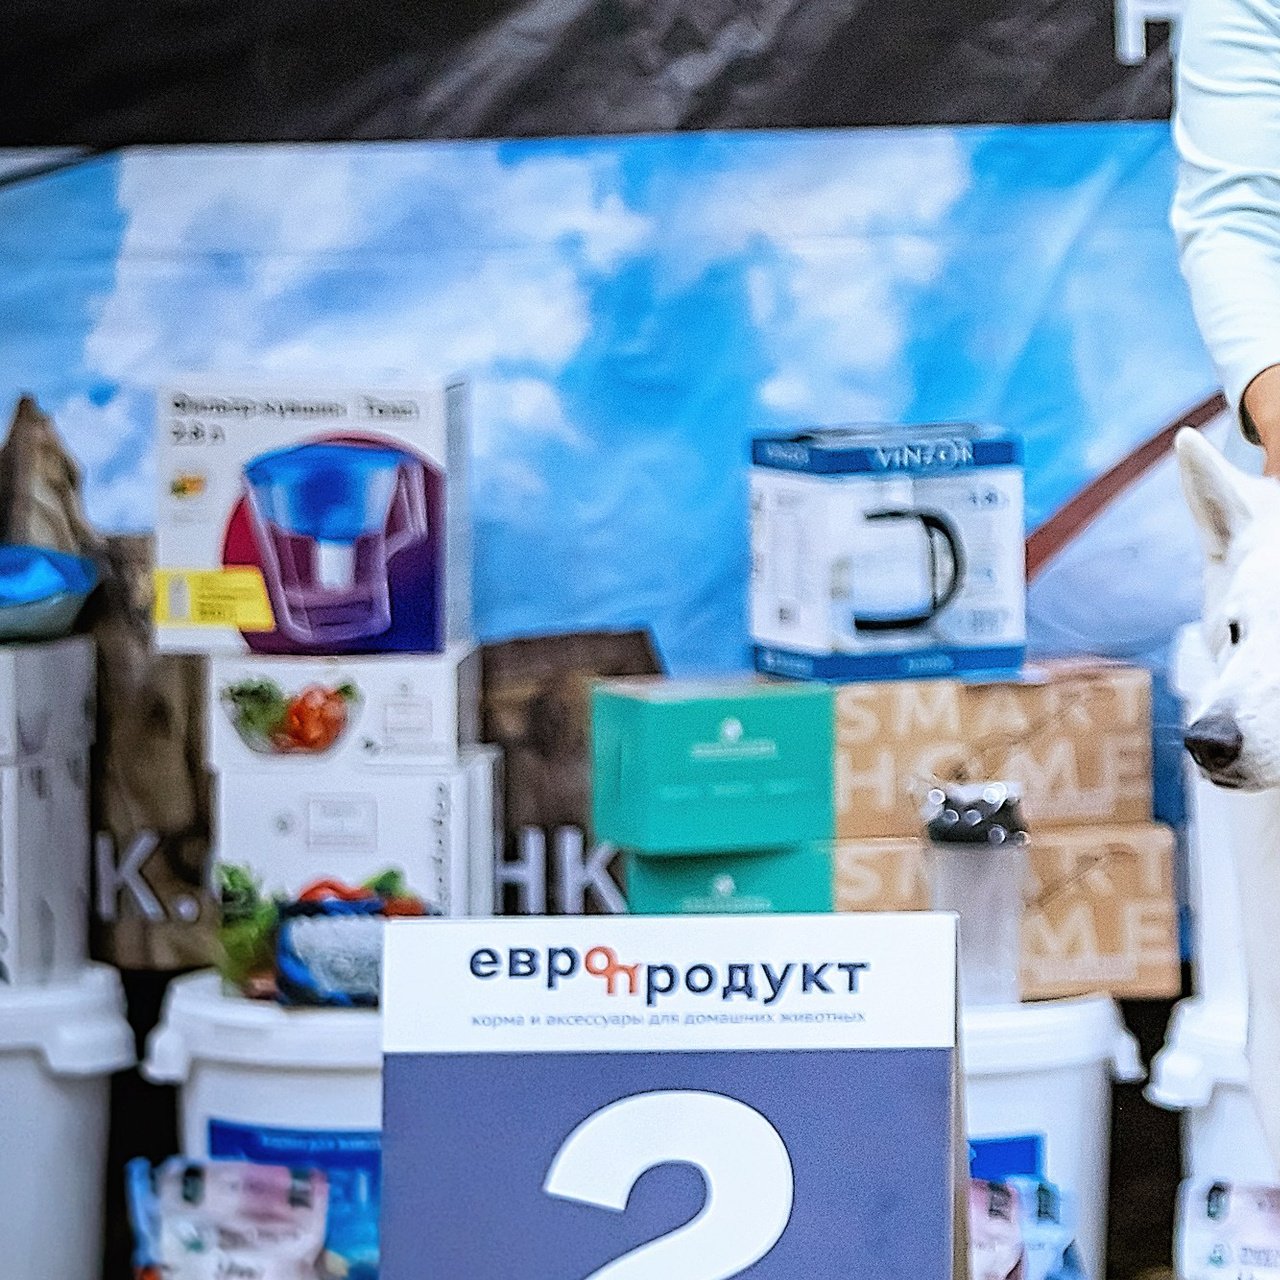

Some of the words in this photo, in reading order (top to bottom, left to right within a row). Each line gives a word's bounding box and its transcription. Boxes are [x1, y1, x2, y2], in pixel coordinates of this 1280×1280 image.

[471, 1015, 525, 1029] корма
[531, 1015, 541, 1025] и
[546, 1013, 645, 1029] аксессуары
[650, 1013, 680, 1026] для
[684, 1012, 774, 1026] домашних
[780, 1010, 867, 1024] животных
